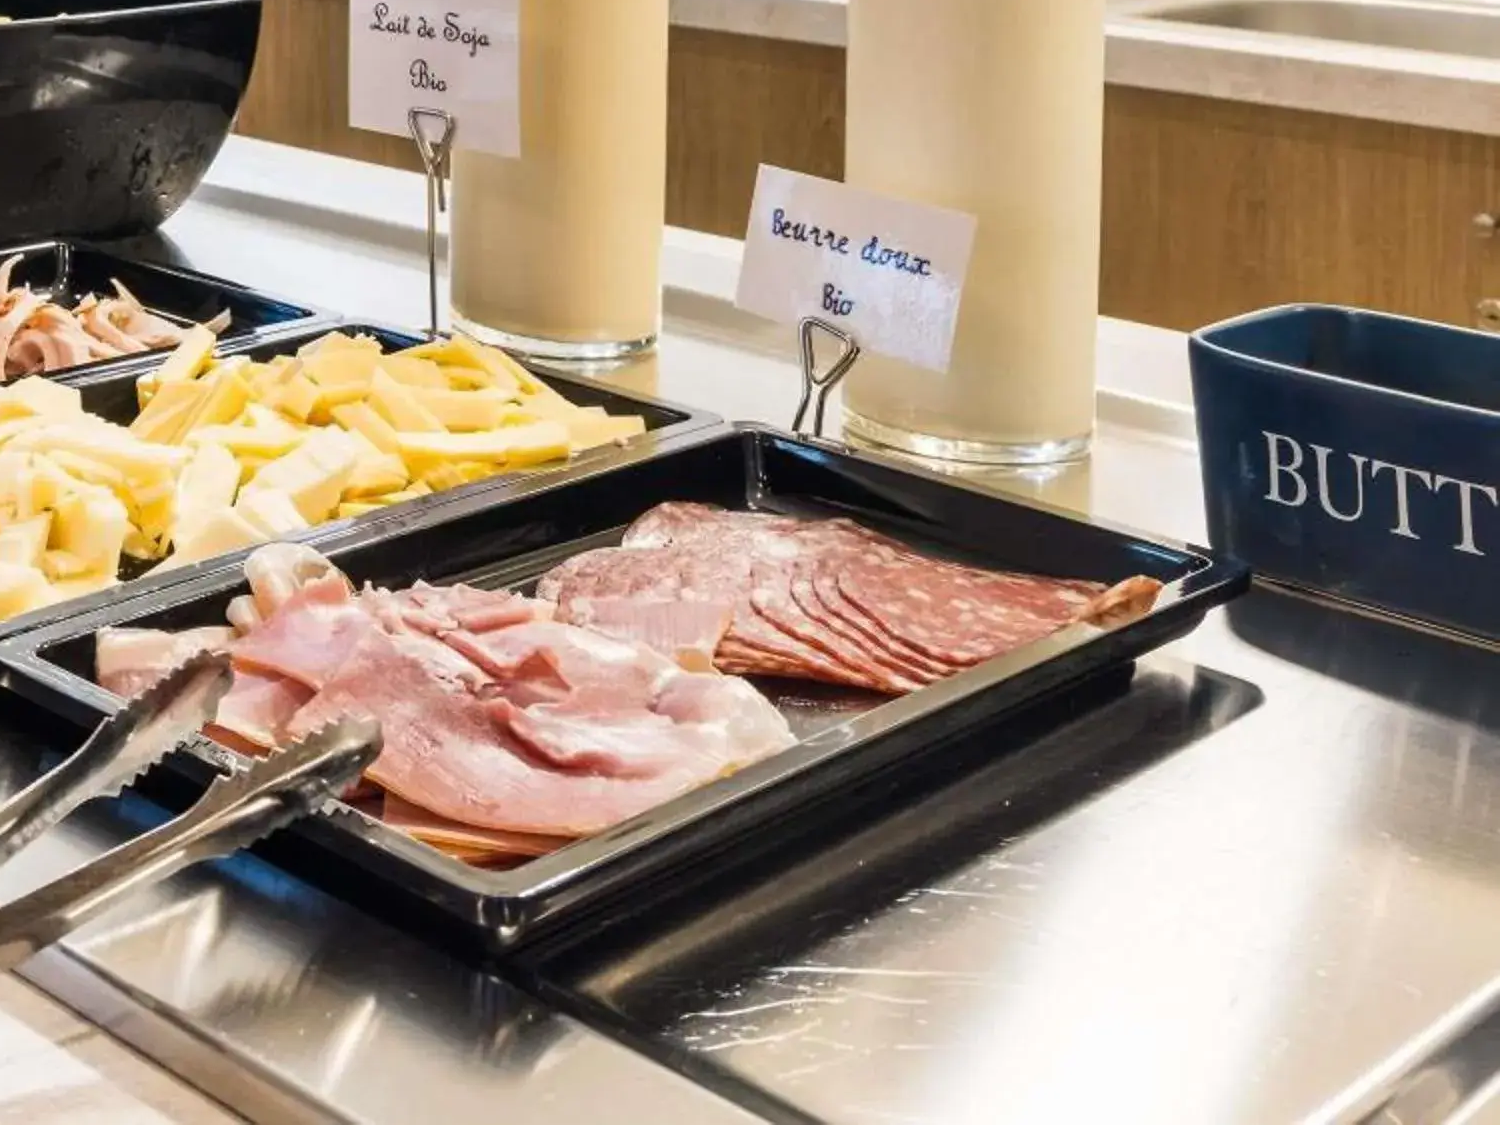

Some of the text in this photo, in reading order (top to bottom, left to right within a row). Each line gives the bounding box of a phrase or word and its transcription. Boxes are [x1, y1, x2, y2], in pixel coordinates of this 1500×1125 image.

[370, 2, 490, 57] Lait de Soja
[409, 59, 448, 92] Bio
[771, 208, 932, 276] Beurre doux
[822, 283, 855, 316] Bio
[1262, 430, 1499, 556] BUTT
